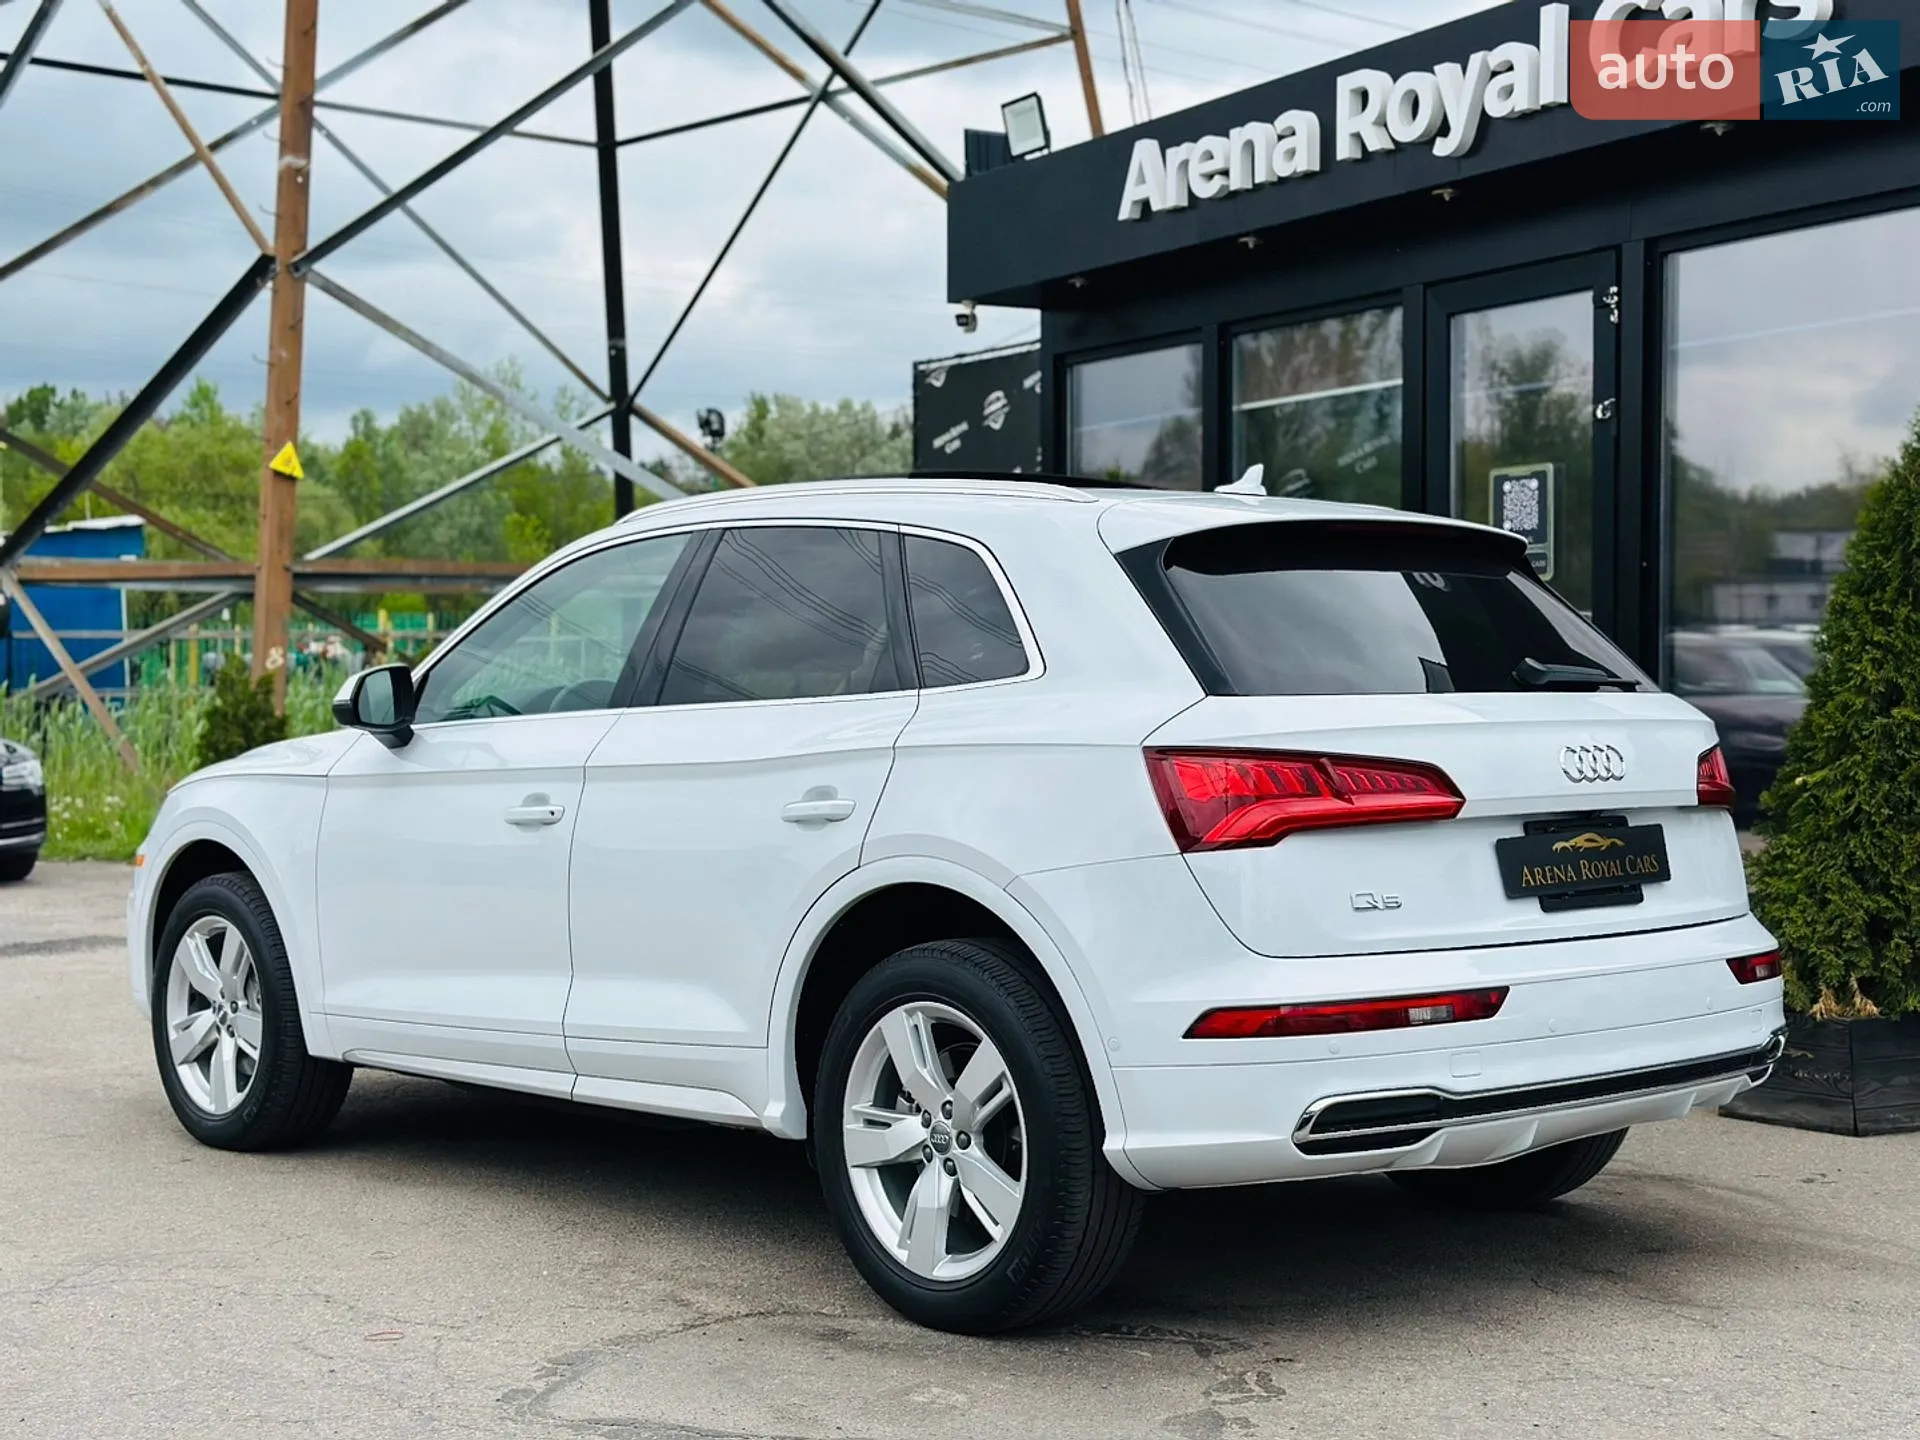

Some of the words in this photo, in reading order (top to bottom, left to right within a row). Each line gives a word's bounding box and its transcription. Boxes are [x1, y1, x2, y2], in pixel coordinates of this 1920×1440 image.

[1117, 109, 1321, 221] Arena
[1336, 3, 1570, 161] Royal
[1522, 863, 1577, 888] ARENA
[1580, 859, 1624, 880] ROYAL
[1625, 854, 1660, 875] CARS
[1350, 891, 1403, 912] Q5
